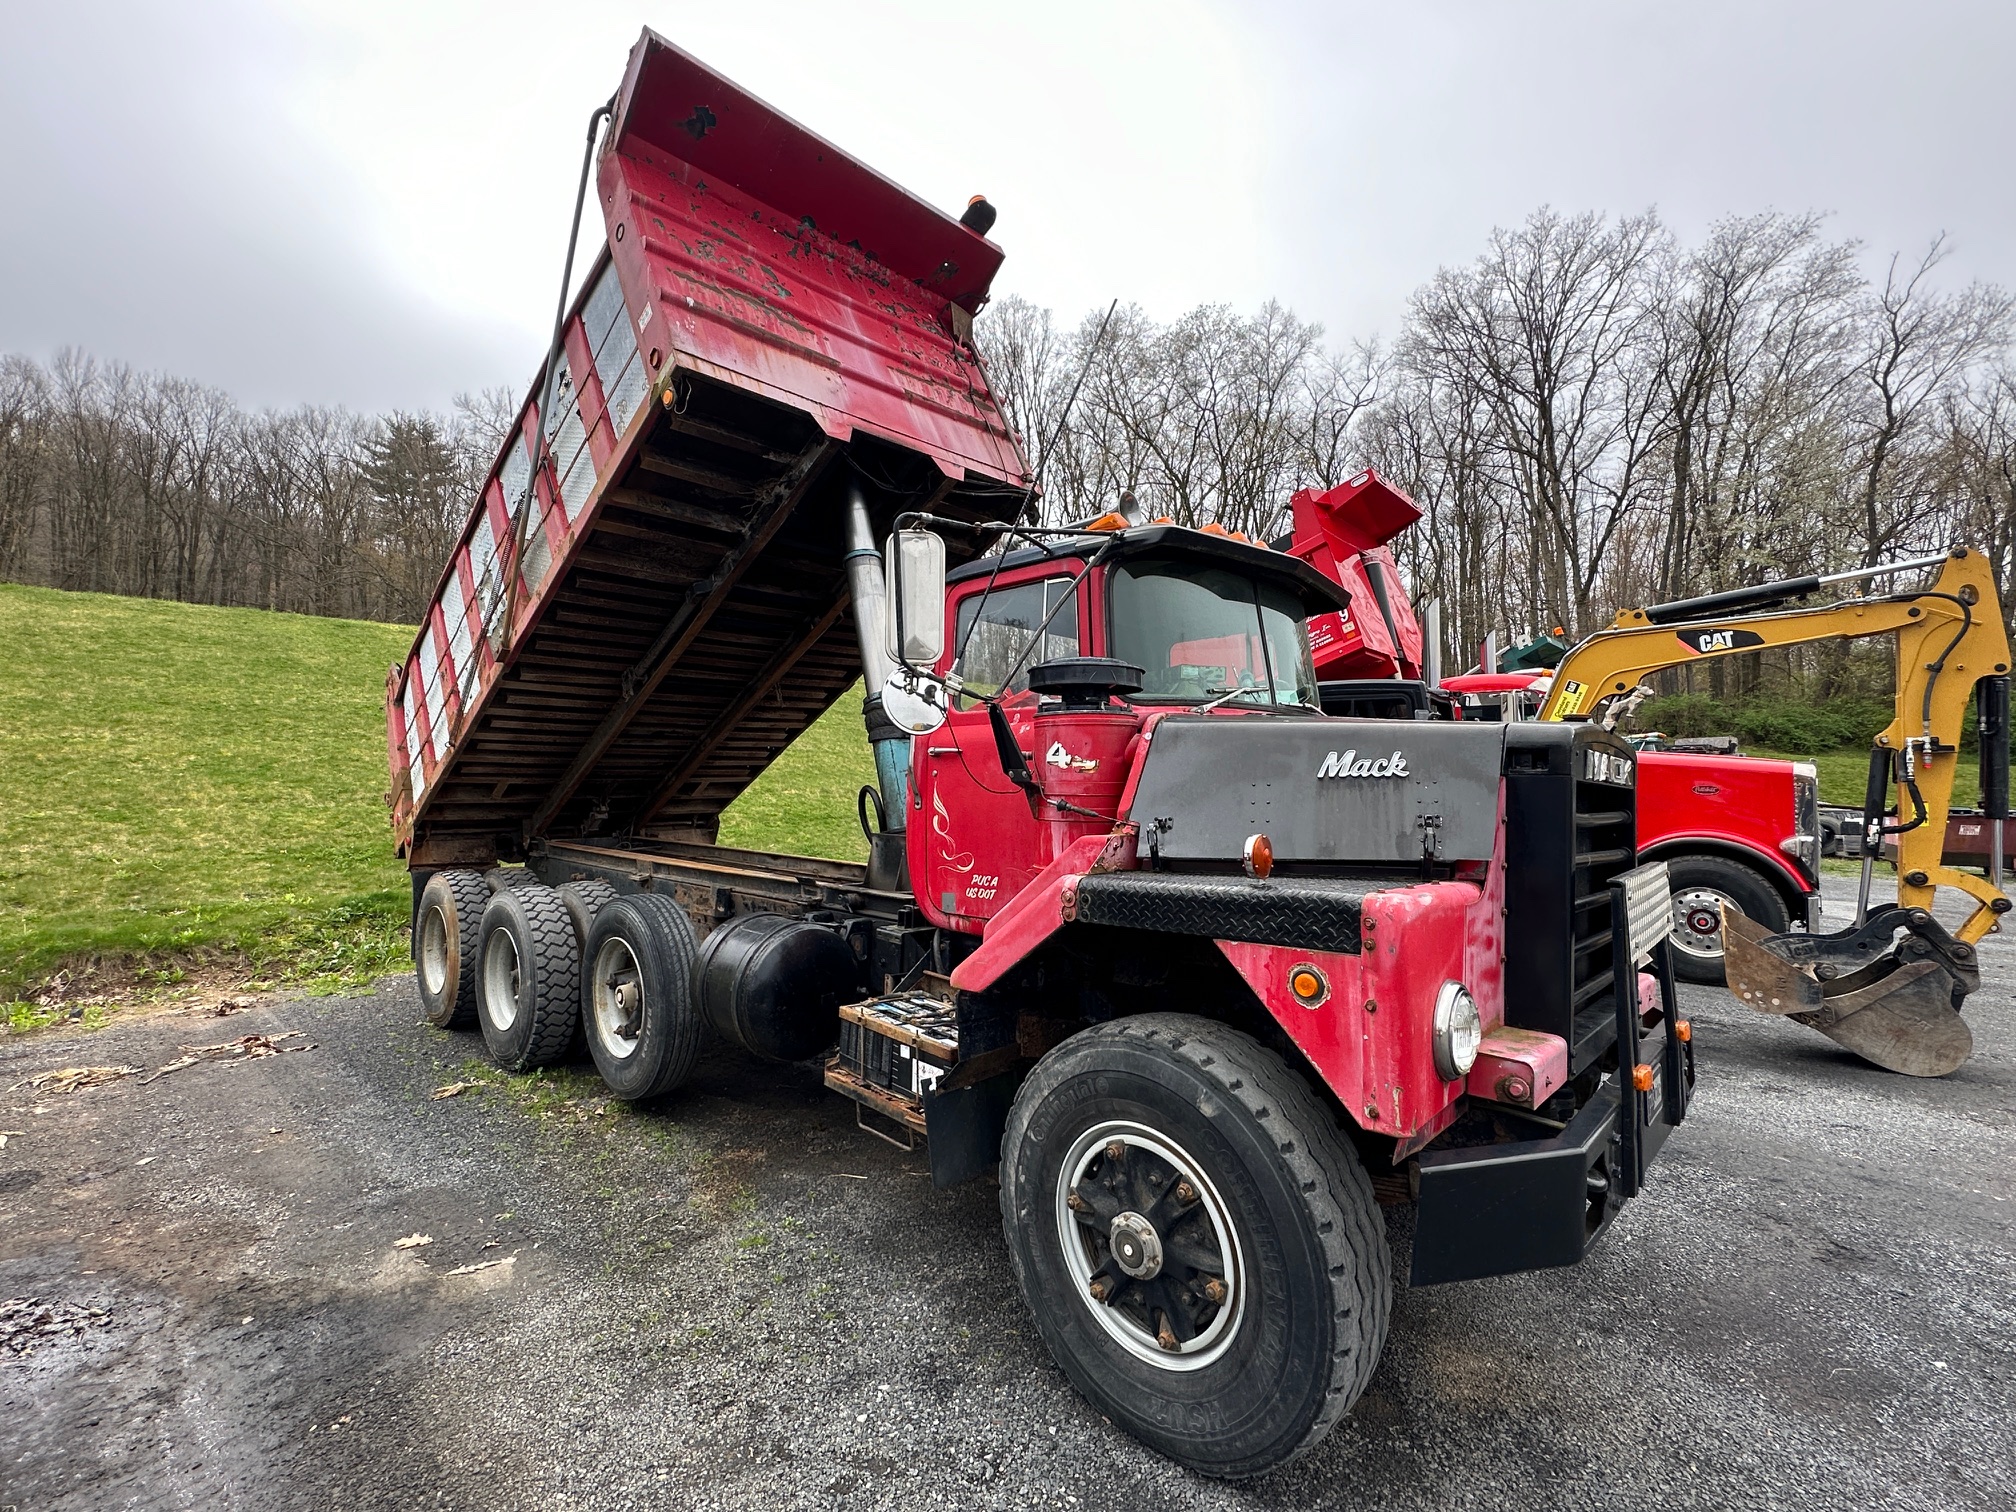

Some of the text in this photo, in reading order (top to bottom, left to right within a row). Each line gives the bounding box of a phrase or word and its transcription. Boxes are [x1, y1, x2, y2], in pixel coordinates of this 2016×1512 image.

[1699, 630, 1734, 652] CAT
[1317, 749, 1410, 779] Mack
[971, 874, 999, 887] PUC A
[965, 887, 997, 900] US DOT
